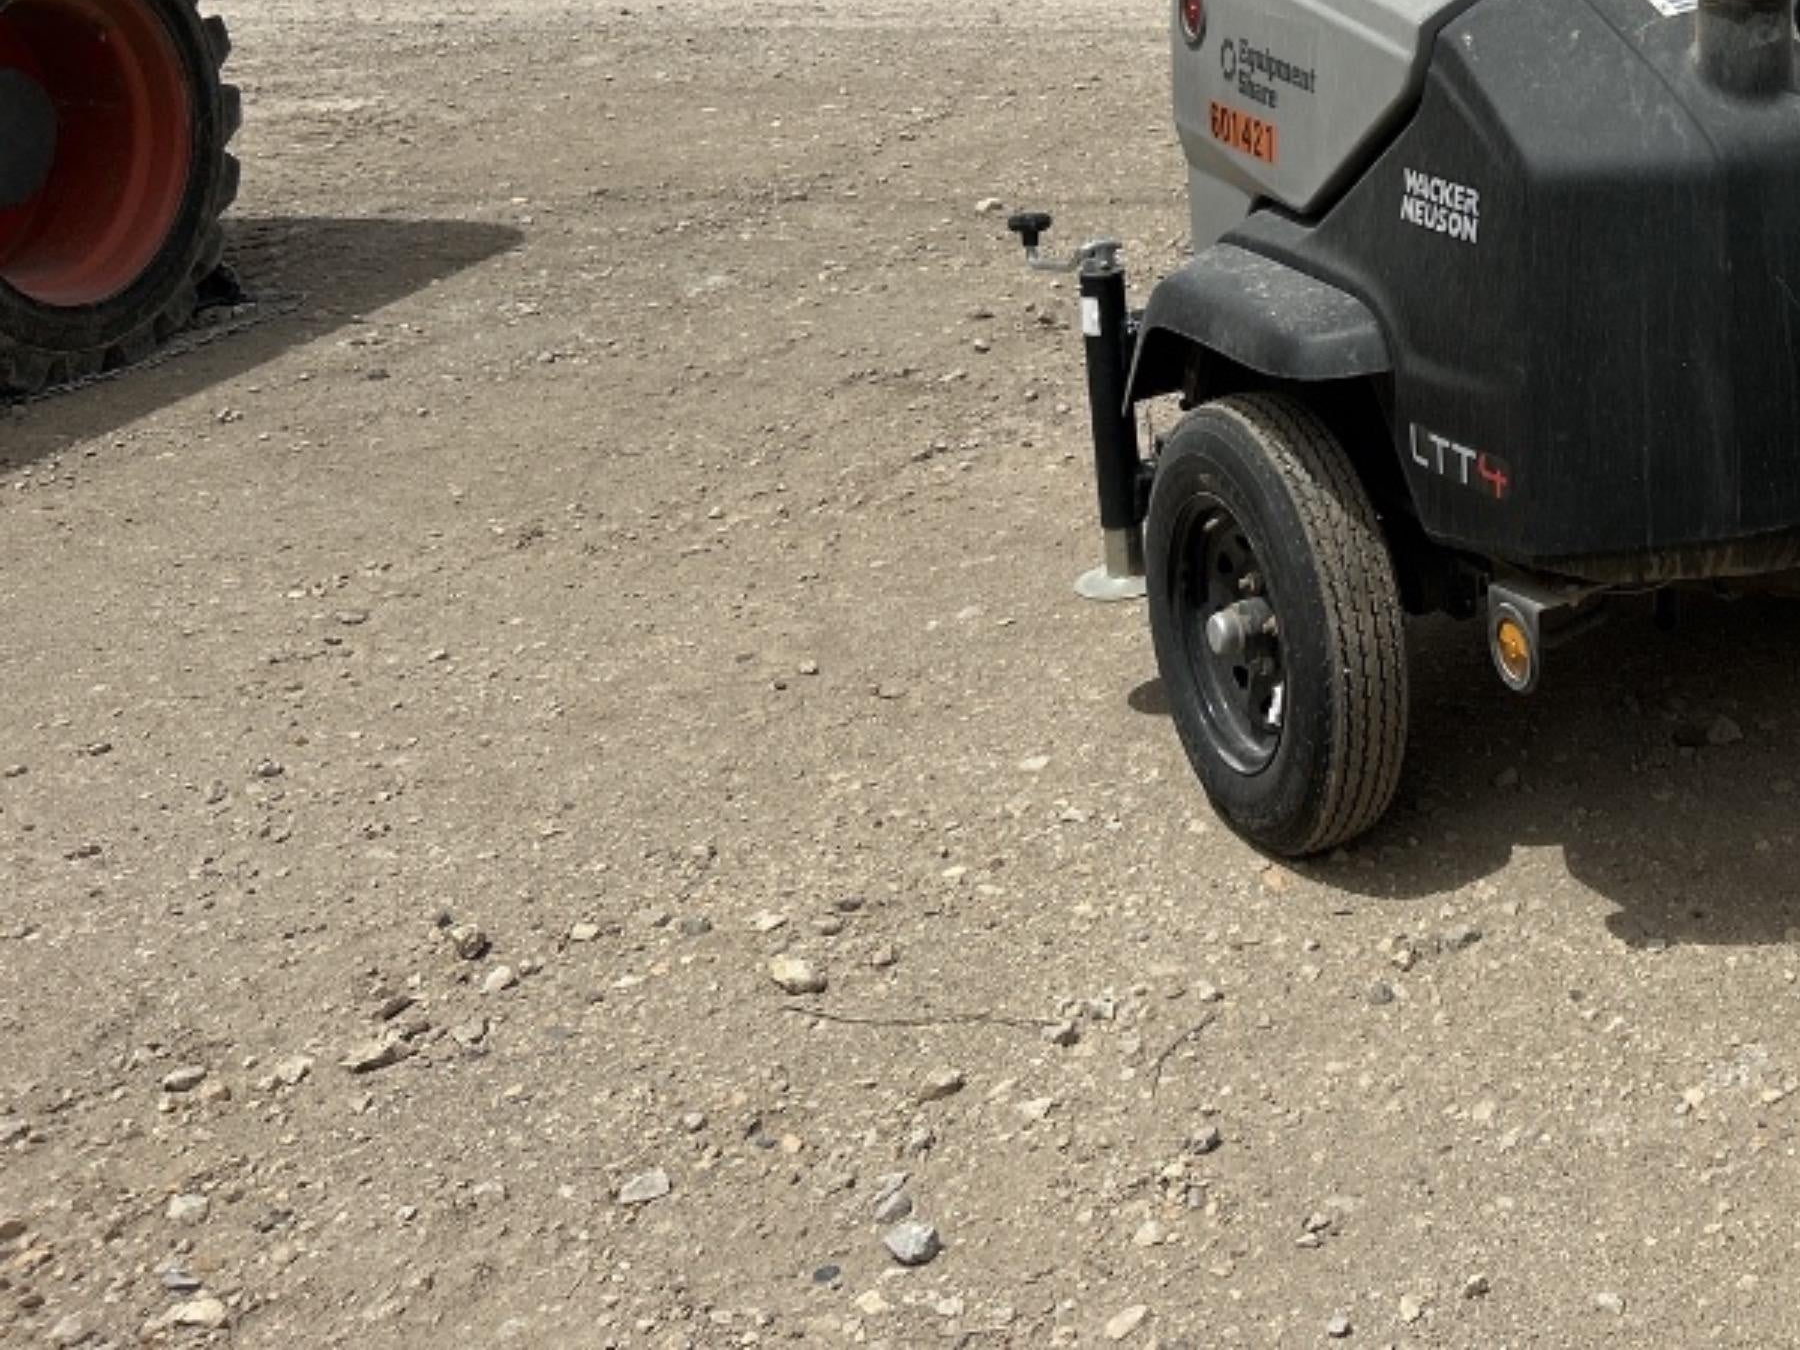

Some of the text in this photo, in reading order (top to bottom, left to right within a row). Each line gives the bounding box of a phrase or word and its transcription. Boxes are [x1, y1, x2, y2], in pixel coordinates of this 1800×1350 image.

[1238, 69, 1277, 108] Share
[1239, 38, 1317, 94] Equipment
[1211, 101, 1273, 163] 601421
[1403, 167, 1479, 216] WACKER
[1401, 194, 1478, 244] NEUSON
[1409, 421, 1507, 499] LTT4
